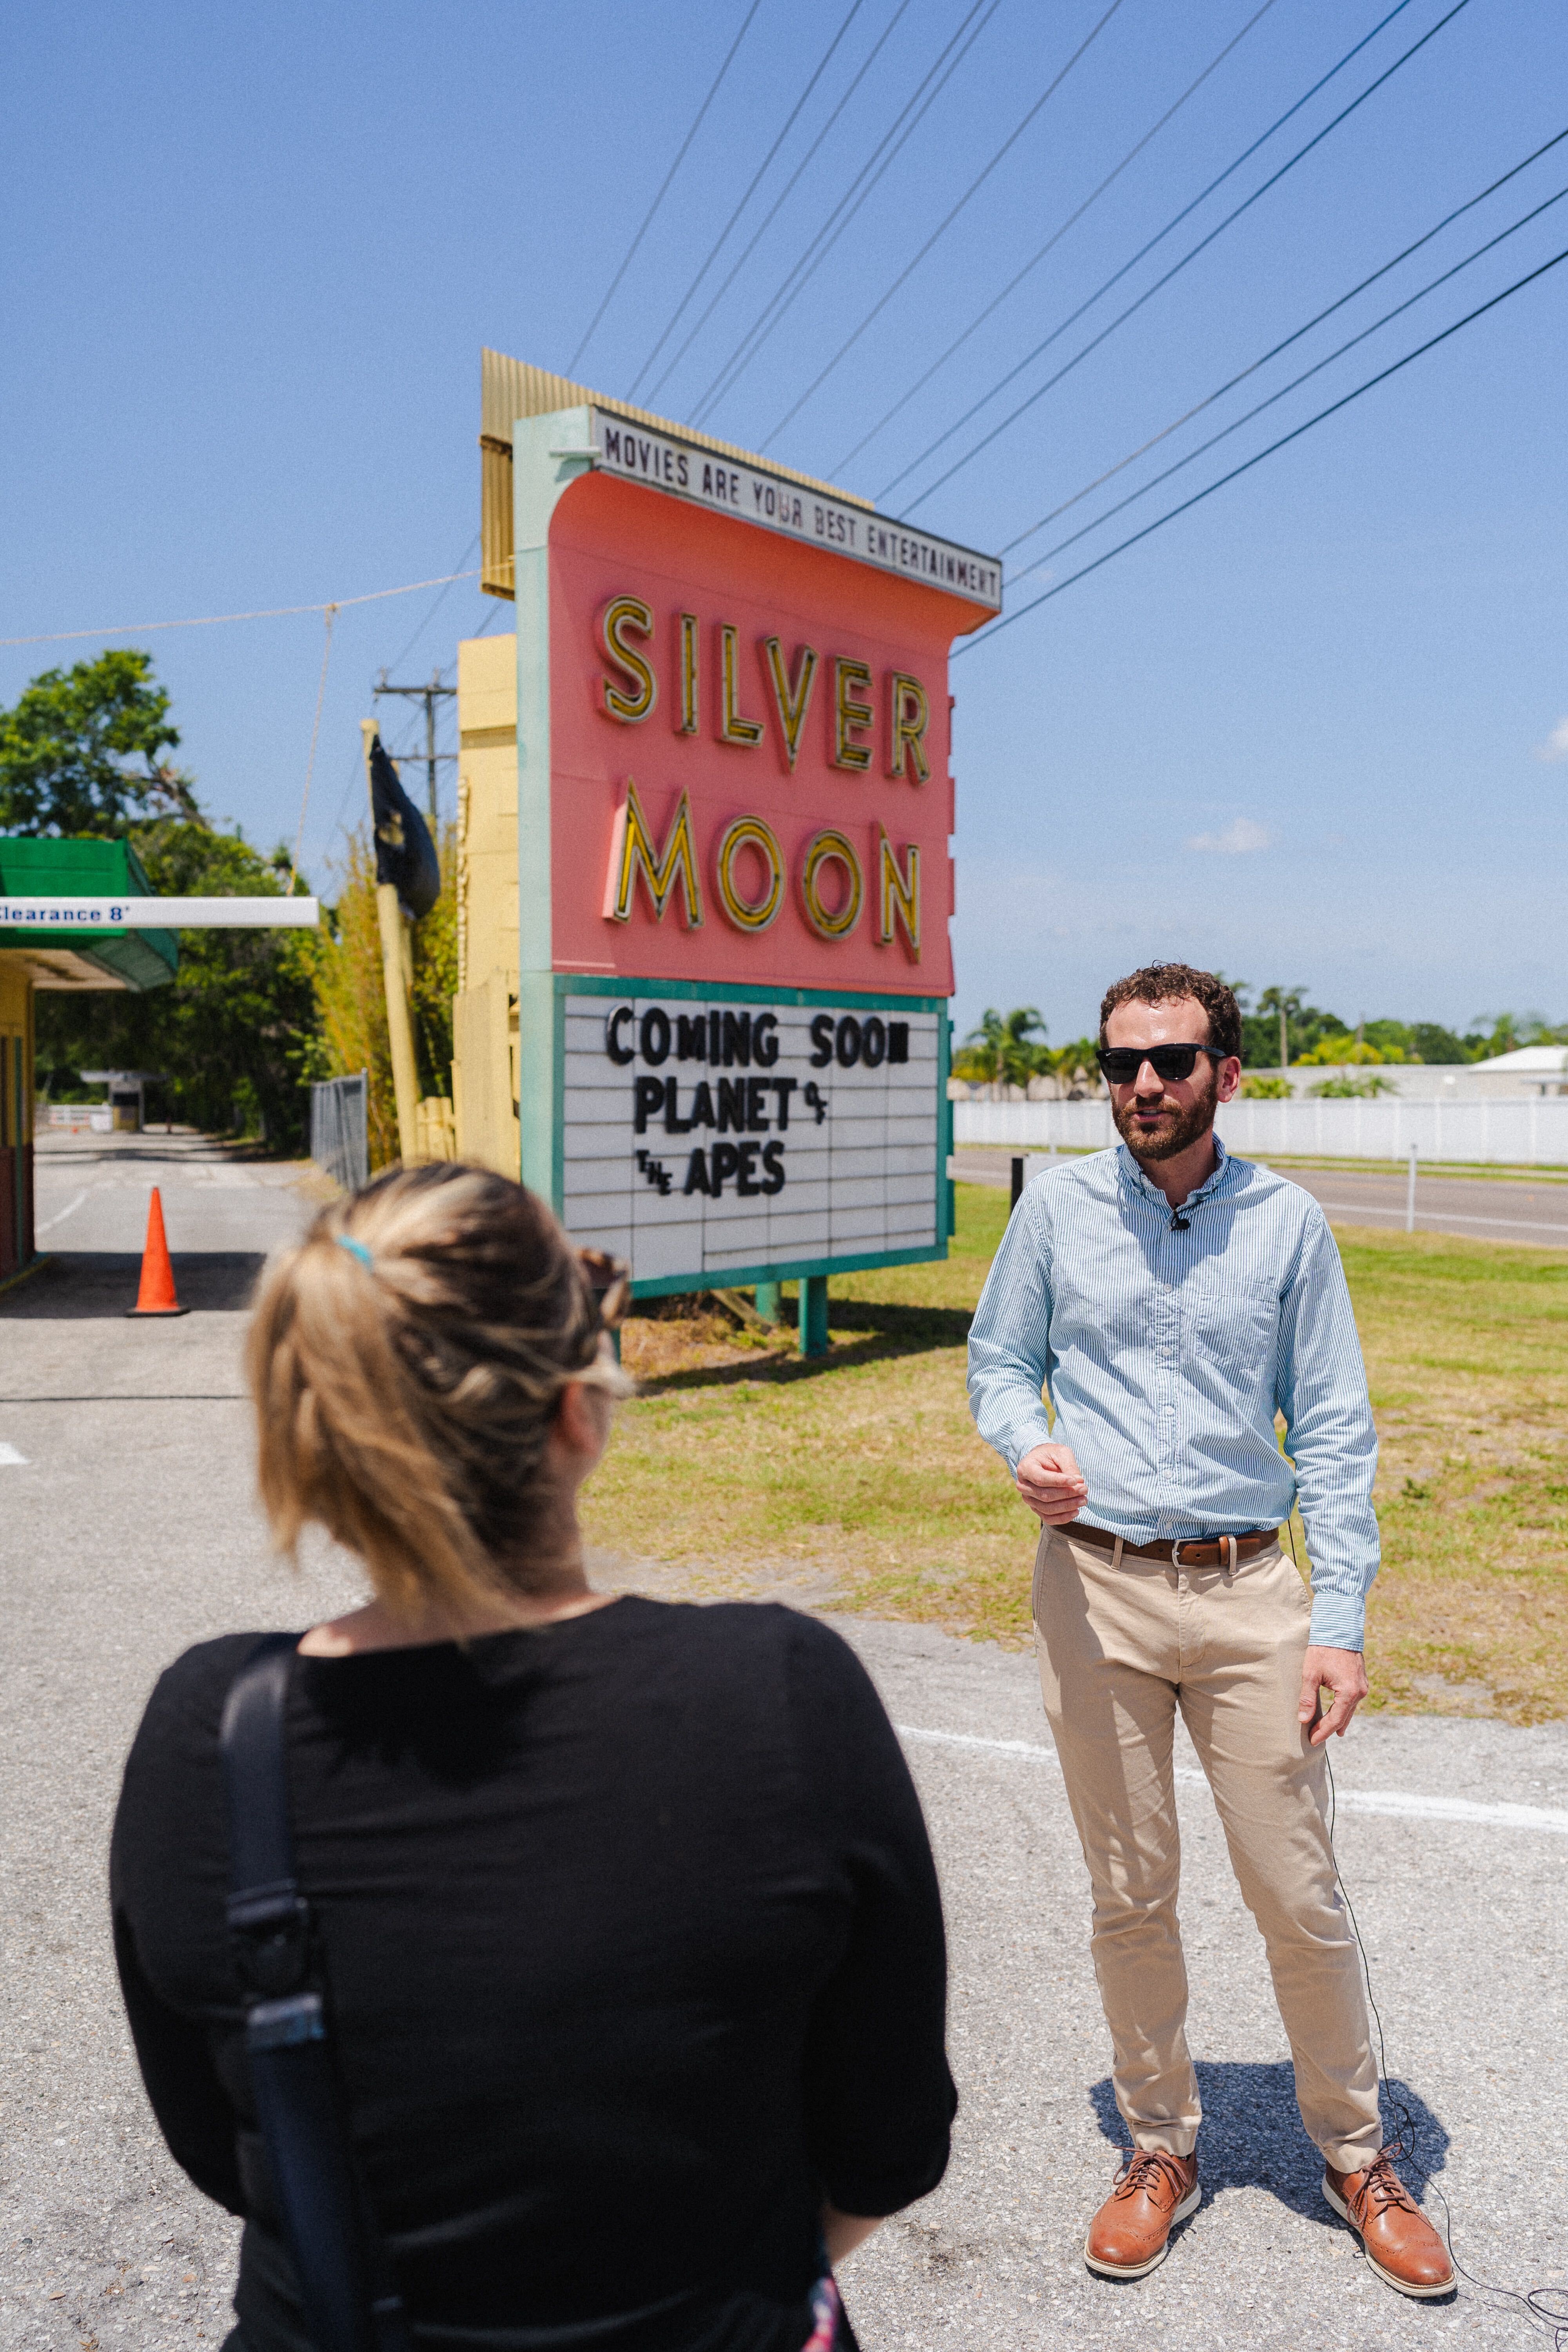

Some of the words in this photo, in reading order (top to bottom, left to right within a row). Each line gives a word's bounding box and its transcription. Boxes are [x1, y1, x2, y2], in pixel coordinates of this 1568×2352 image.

[605, 427, 688, 486] MOVIES
[703, 463, 739, 504] ARE
[815, 505, 855, 547] BEST
[867, 524, 996, 595] ENTERTAINMENT
[600, 594, 930, 784] SILVER
[606, 775, 921, 964] MOON
[0, 906, 100, 920] learance
[606, 1004, 780, 1067] COMING
[634, 1076, 797, 1134] PLANET
[684, 1140, 785, 1198] APES
